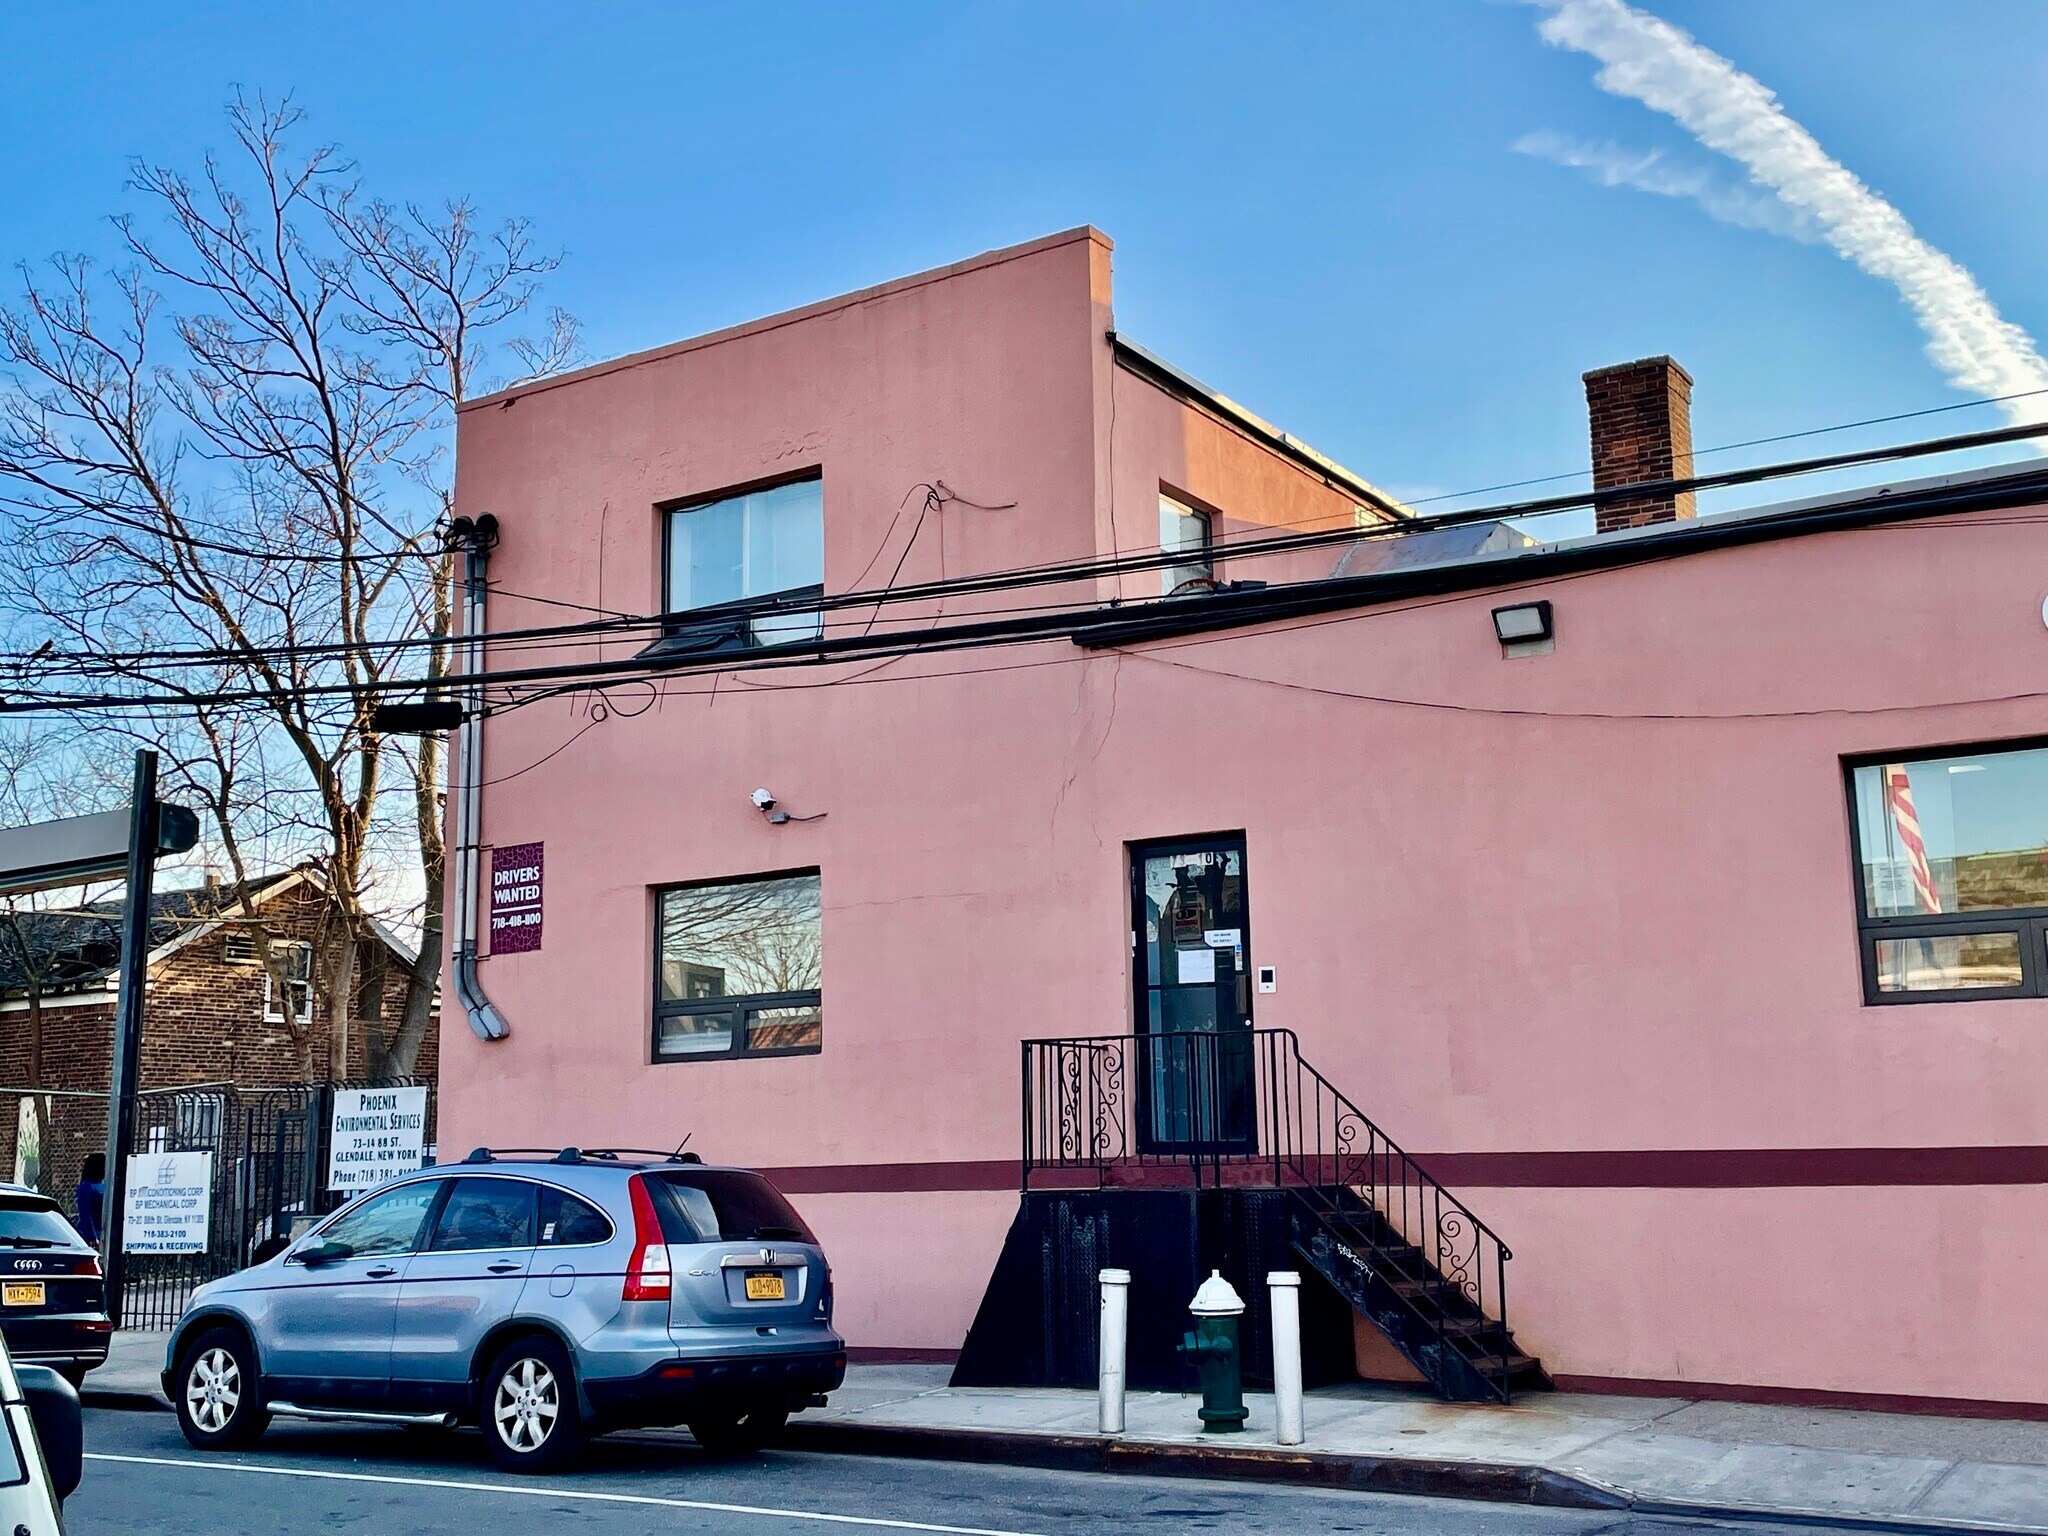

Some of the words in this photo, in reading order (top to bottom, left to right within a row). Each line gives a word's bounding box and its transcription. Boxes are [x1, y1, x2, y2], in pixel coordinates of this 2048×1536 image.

[494, 866, 540, 886] DRIVERS
[494, 885, 540, 904] WANTED
[492, 912, 541, 929] 718-418-1100
[360, 1094, 397, 1111] PHOENIX
[336, 1115, 387, 1132] ENVIRONMENTAL
[390, 1112, 421, 1130] SERVICES
[353, 1138, 375, 1149] 73-14
[378, 1138, 388, 1148] 88
[390, 1136, 402, 1148] ST.
[335, 1150, 376, 1162] GLENDALE,
[377, 1149, 395, 1161] NEW
[397, 1149, 418, 1160] YORK
[332, 1170, 356, 1186] Phone
[357, 1169, 378, 1185] (718)
[126, 1242, 158, 1250] SHIPPING
[159, 1242, 164, 1250] &
[166, 1241, 203, 1250] RECEIVING
